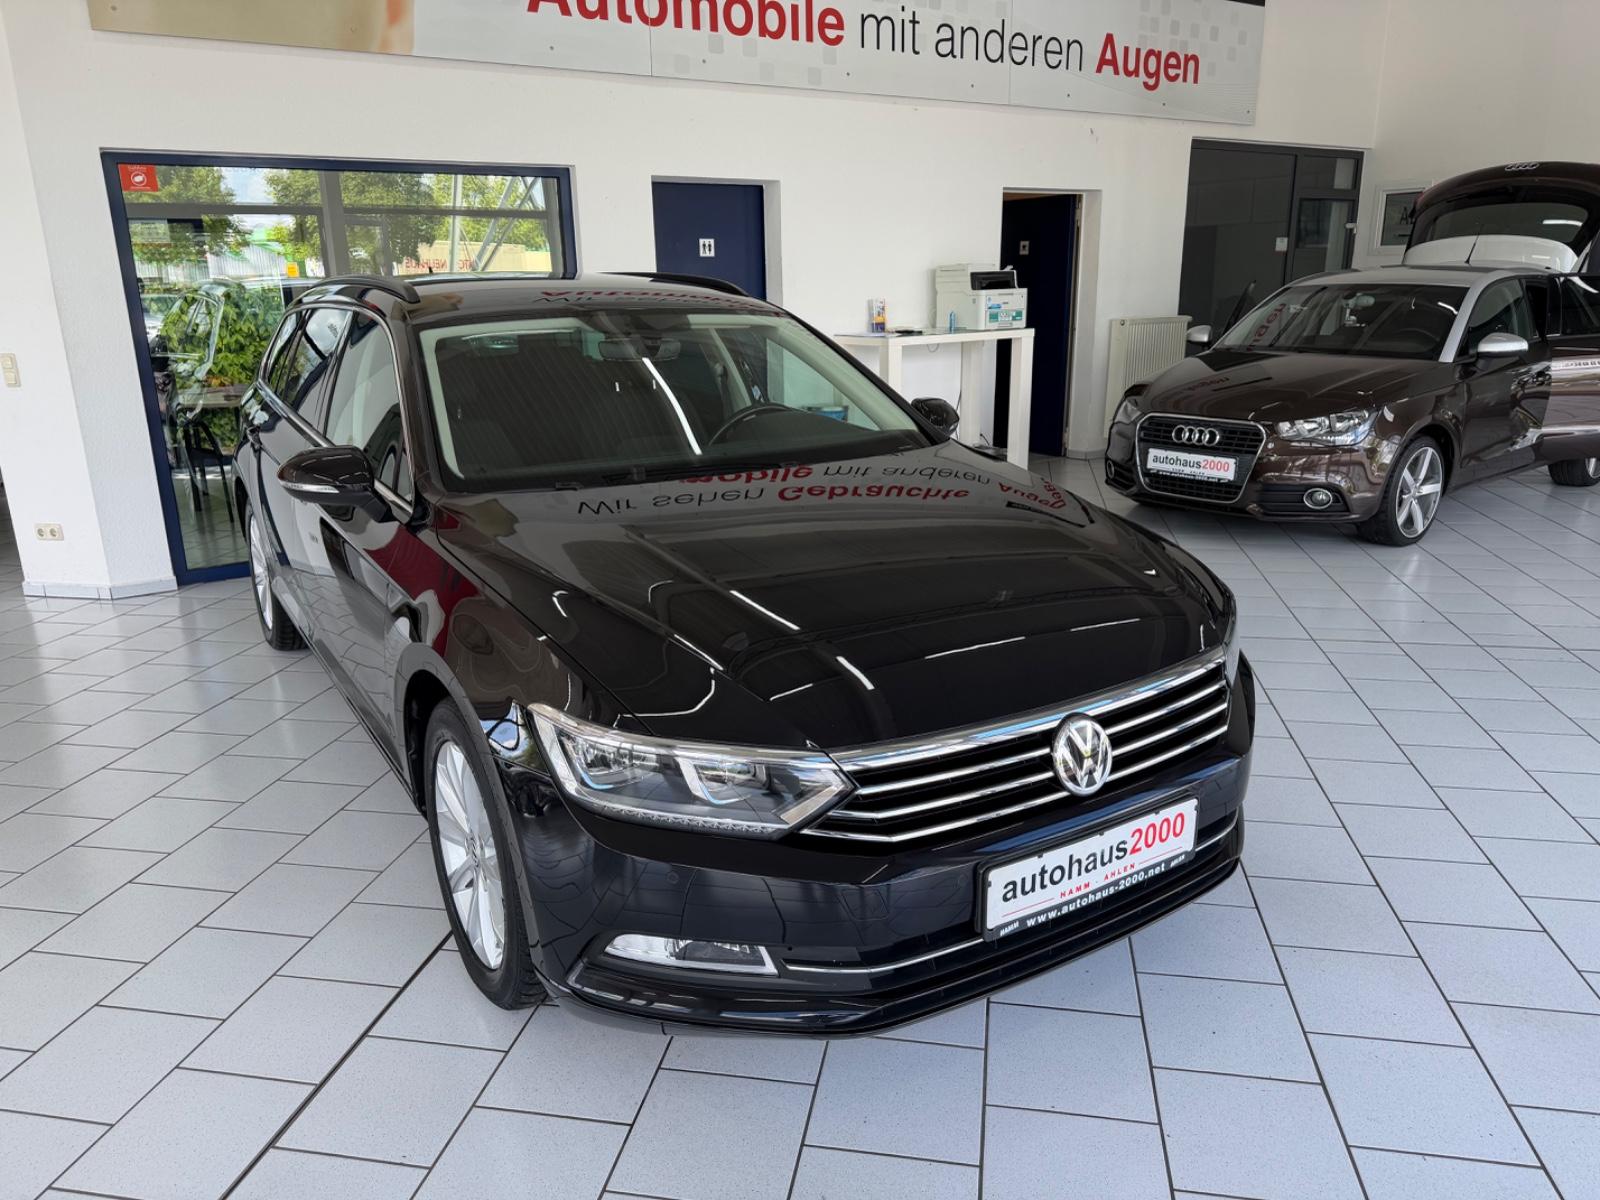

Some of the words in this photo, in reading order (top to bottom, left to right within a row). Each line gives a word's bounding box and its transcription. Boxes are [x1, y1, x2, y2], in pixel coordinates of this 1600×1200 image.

[527, 0, 845, 46] utomobile
[860, 6, 921, 56] mit
[934, 19, 1084, 72] anderen
[1096, 32, 1200, 91] Augen
[1152, 454, 1230, 473] autohaus2000
[1001, 812, 1185, 903] autohaus2000
[1059, 881, 1091, 899] HAMM
[1103, 863, 1136, 881] AHLEN
[1026, 862, 1166, 927] www.autohaus-2000.net
